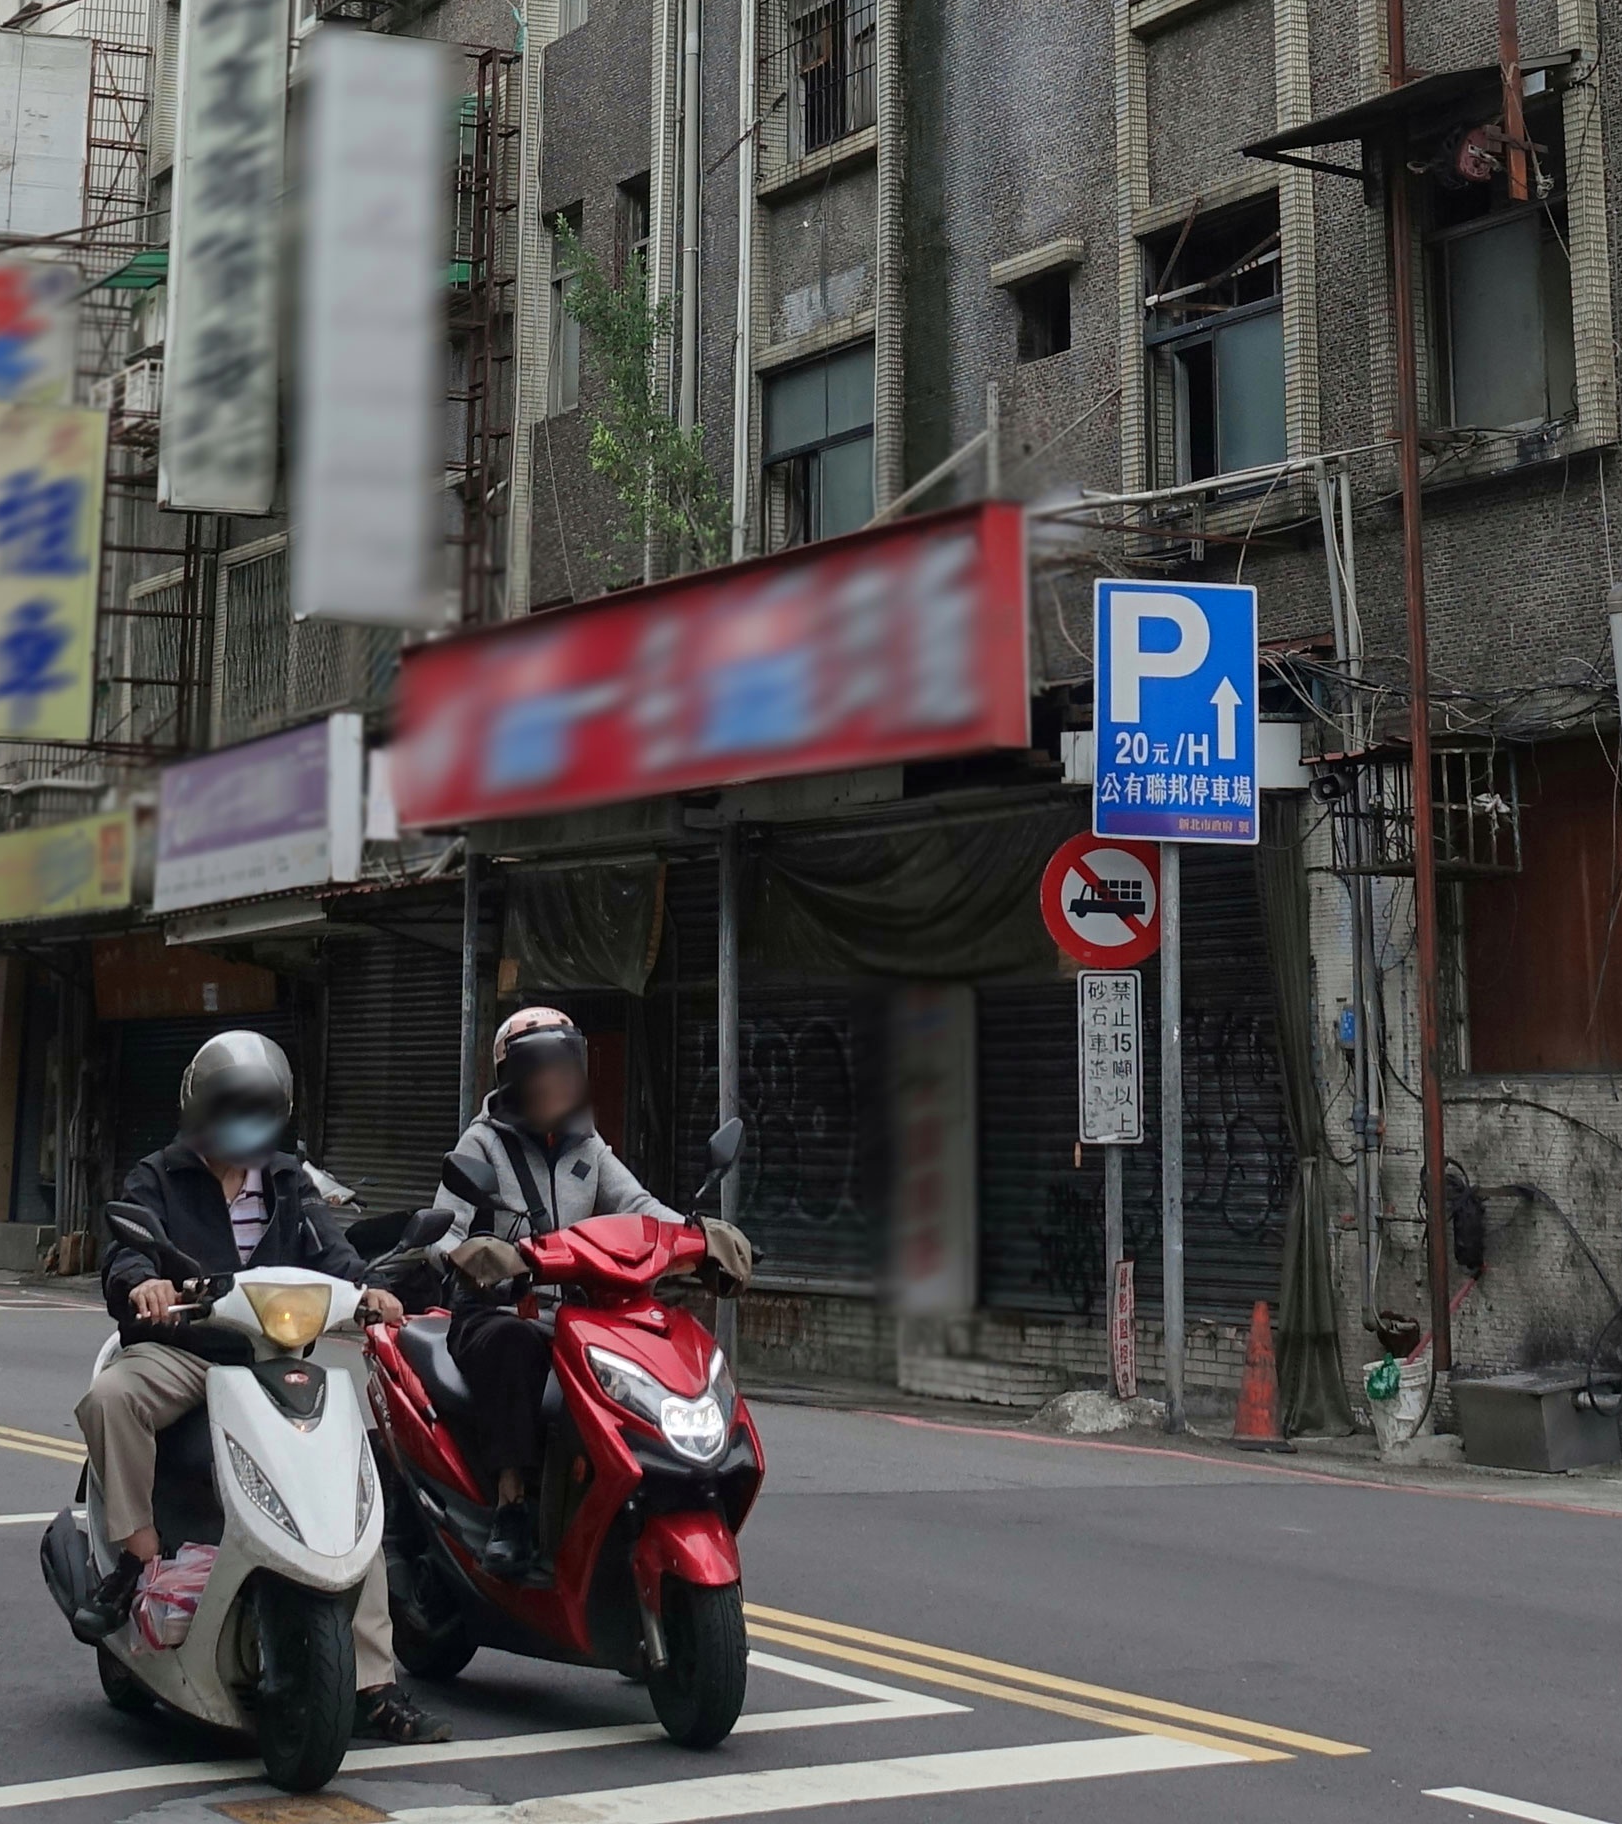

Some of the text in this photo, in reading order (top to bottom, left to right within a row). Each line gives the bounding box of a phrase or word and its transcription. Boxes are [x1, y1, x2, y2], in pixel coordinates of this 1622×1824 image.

[1110, 591, 1210, 723] P
[1100, 772, 1251, 808] 公有聯邦停車場
